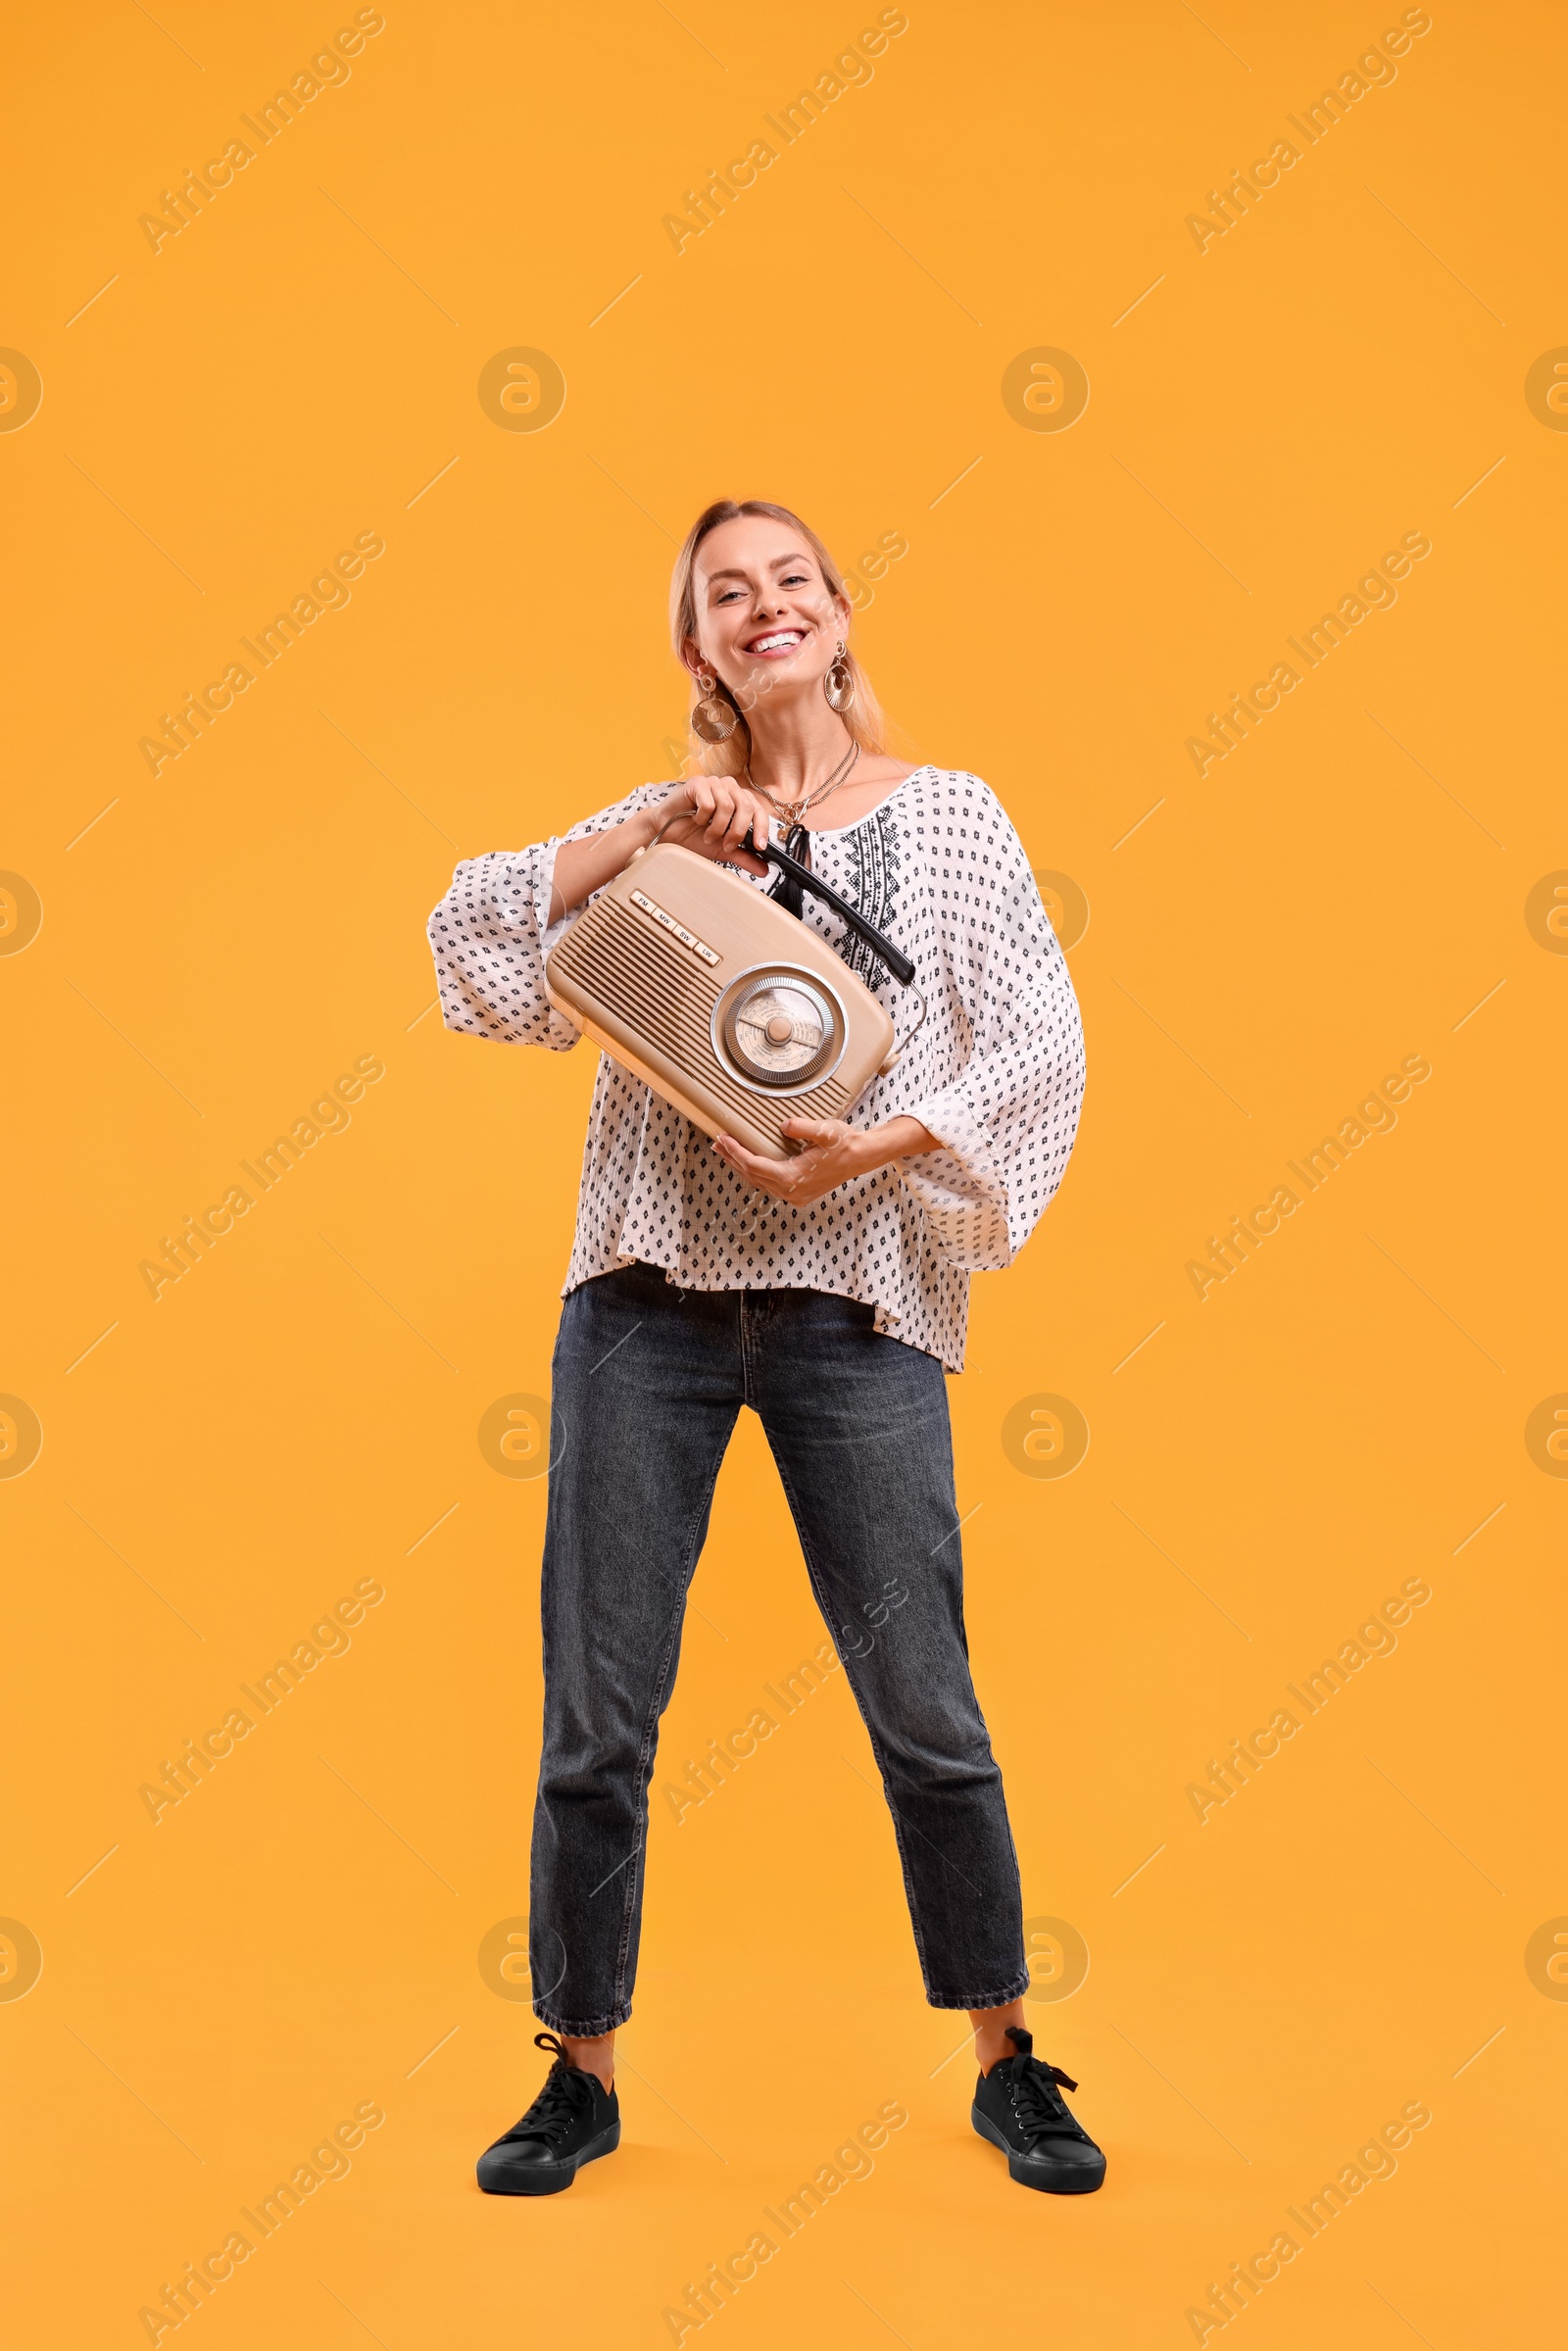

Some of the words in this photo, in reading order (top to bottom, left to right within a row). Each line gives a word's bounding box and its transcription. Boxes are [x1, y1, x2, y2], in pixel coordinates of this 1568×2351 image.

[637, 897, 649, 907] FM
[658, 913, 670, 924] MW
[679, 931, 691, 942] SW
[702, 948, 713, 958] LW
